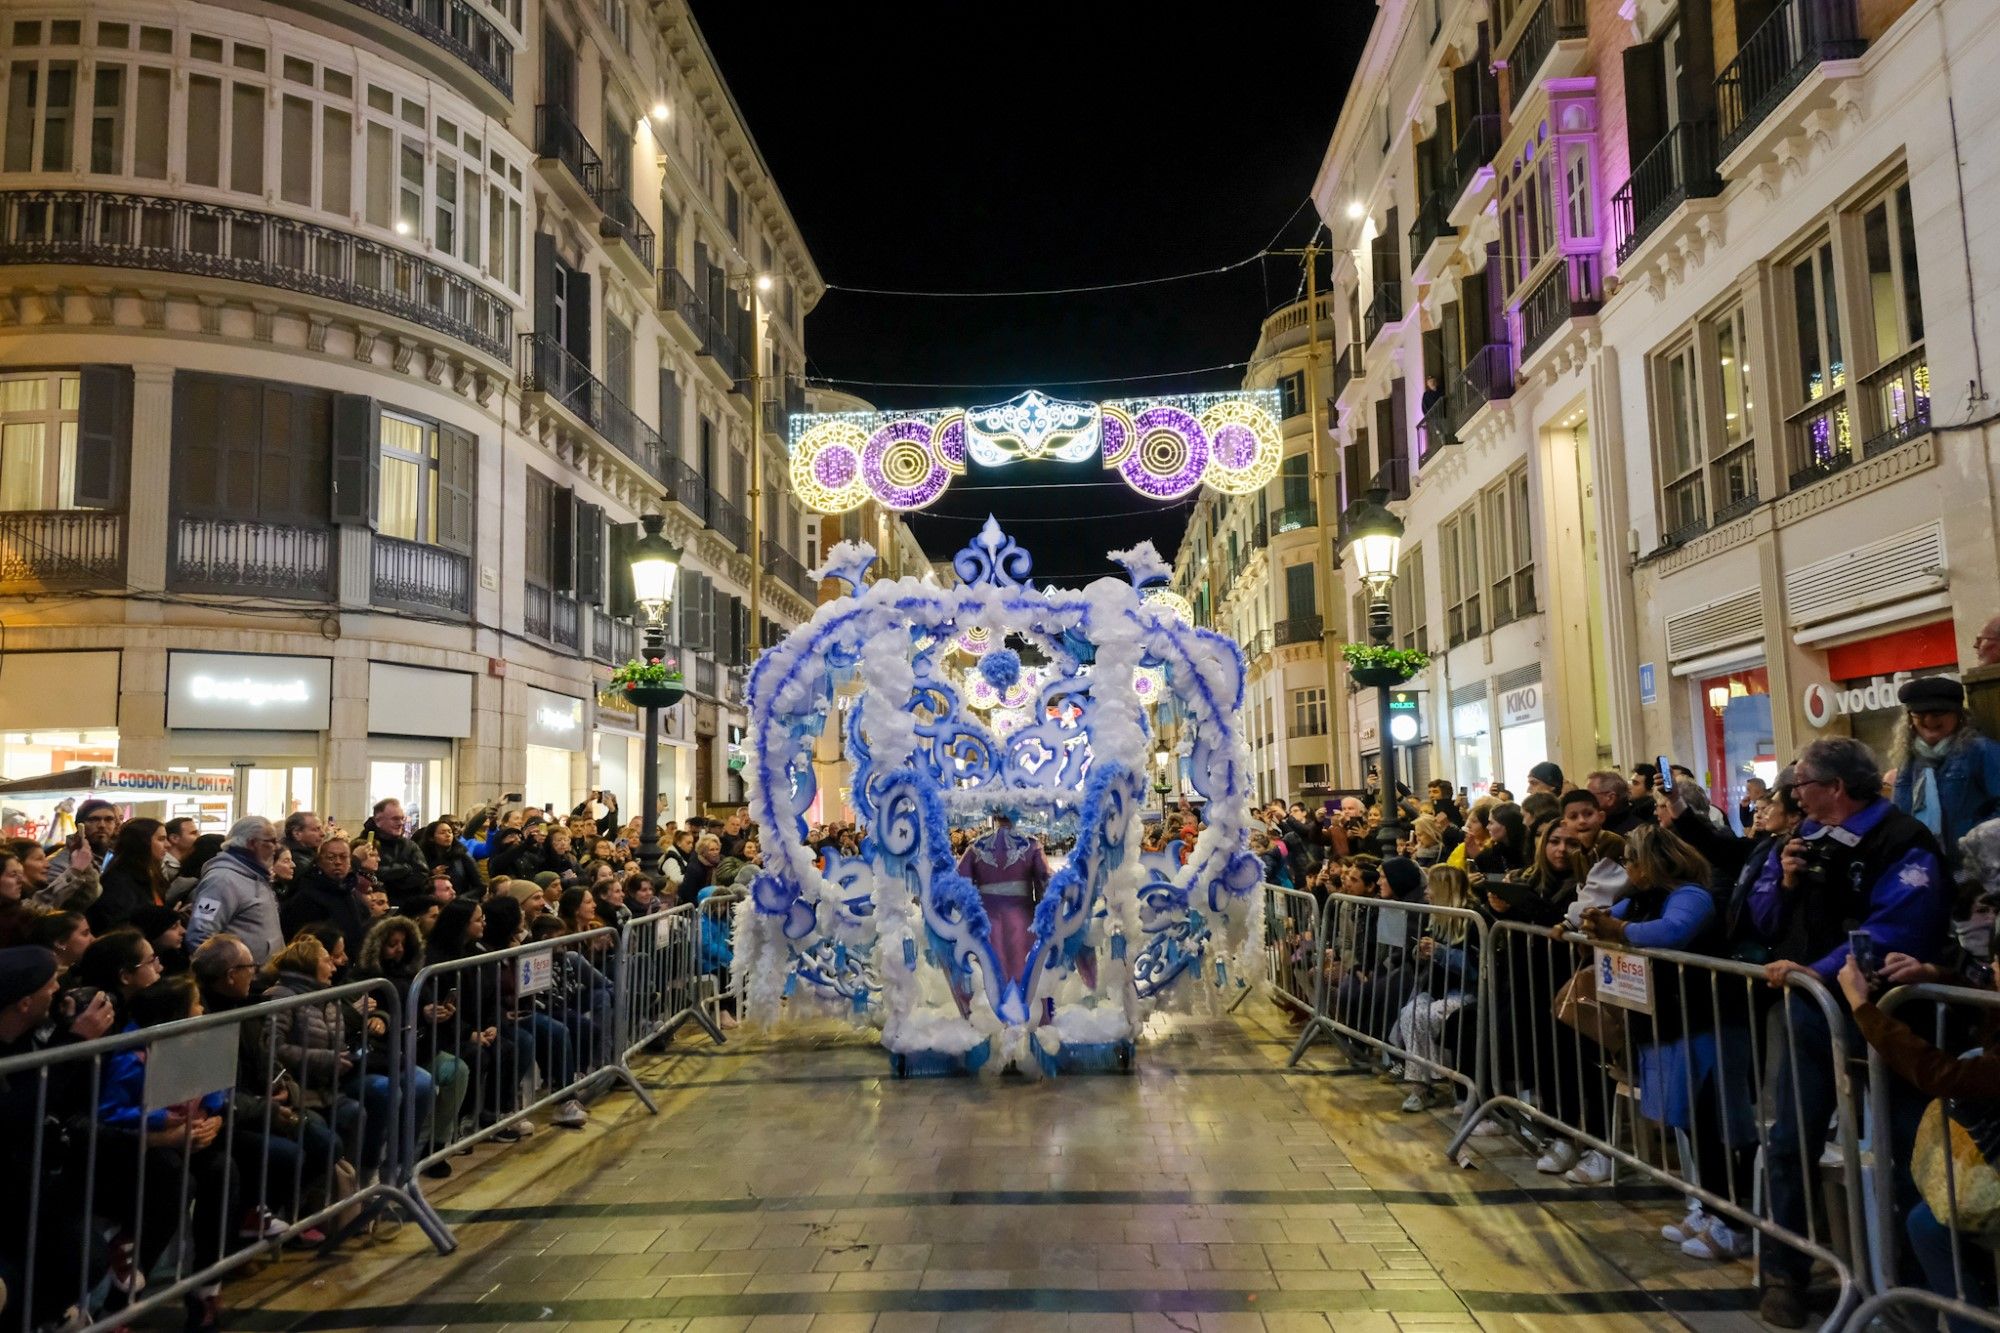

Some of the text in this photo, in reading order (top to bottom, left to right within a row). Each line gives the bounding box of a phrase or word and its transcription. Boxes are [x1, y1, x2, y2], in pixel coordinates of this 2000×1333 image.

[1506, 688, 1536, 715] KIKO
[1836, 671, 1963, 714] vodaf
[1616, 955, 1644, 977] fersa
